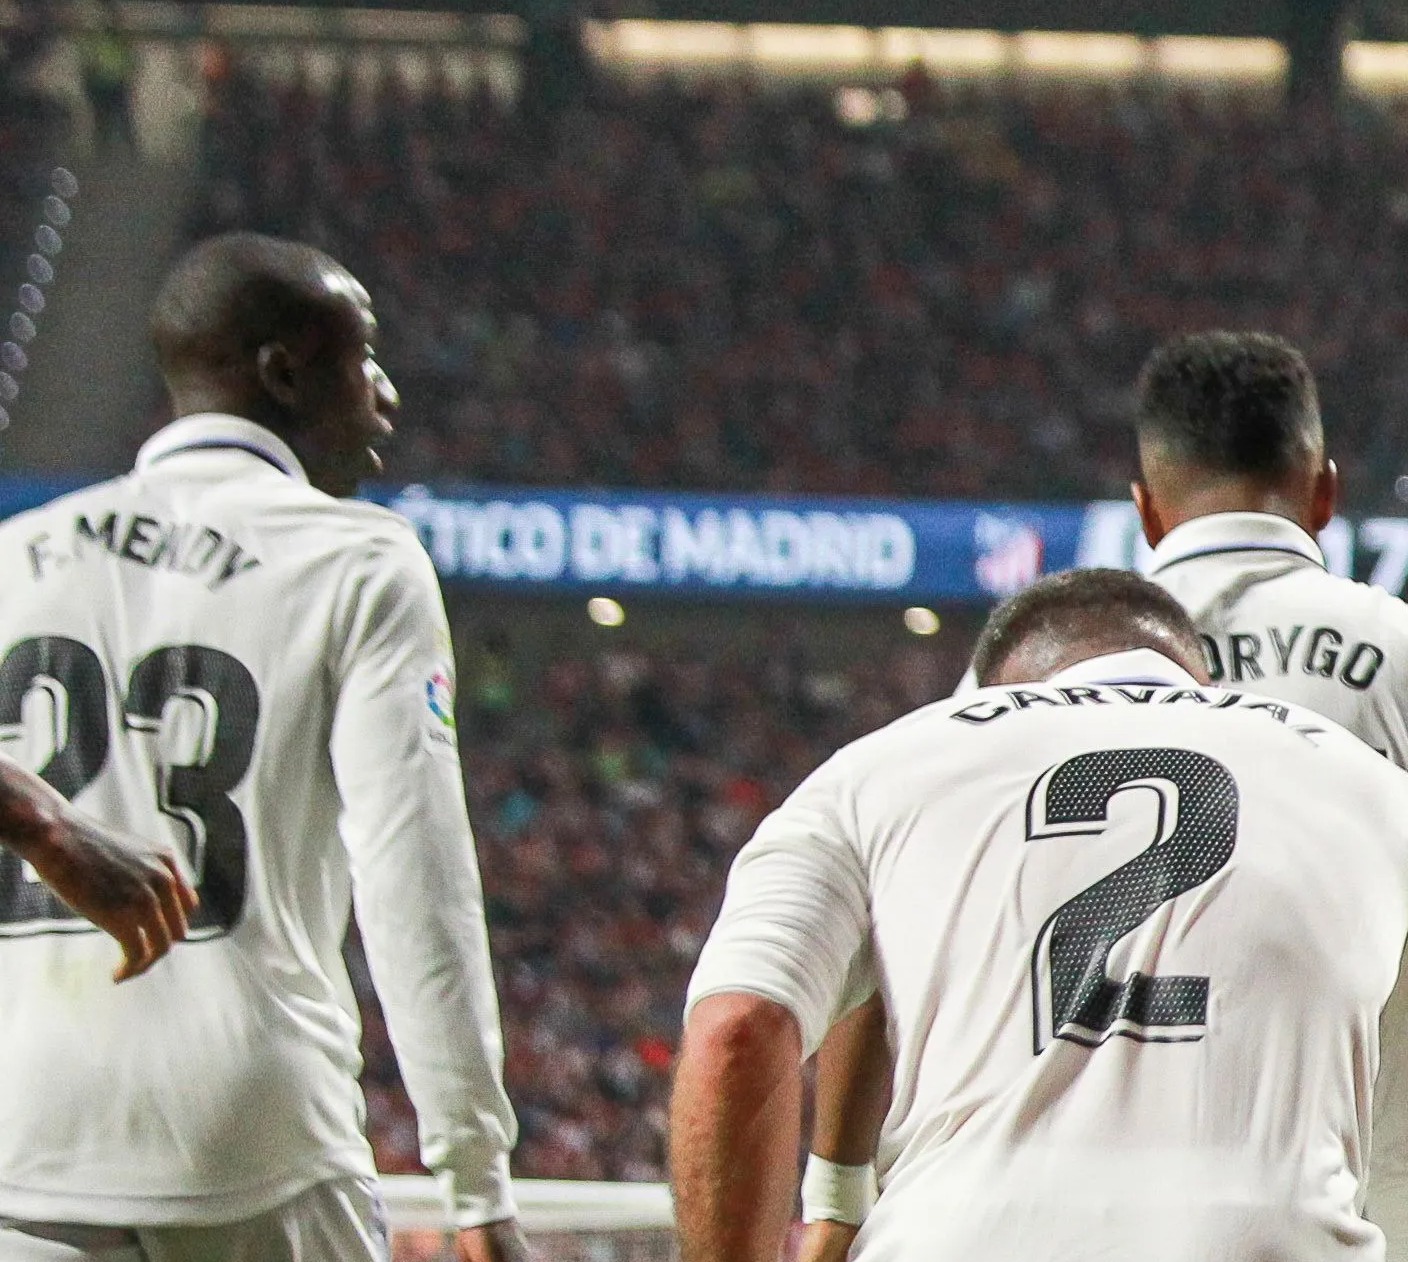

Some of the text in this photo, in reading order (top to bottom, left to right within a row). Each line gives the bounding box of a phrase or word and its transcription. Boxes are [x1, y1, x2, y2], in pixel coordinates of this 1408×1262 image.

[569, 503, 660, 582] DE
[662, 506, 916, 590] MADRID
[949, 686, 1328, 748] CARVAJAL
[1025, 746, 1241, 1056] 2
